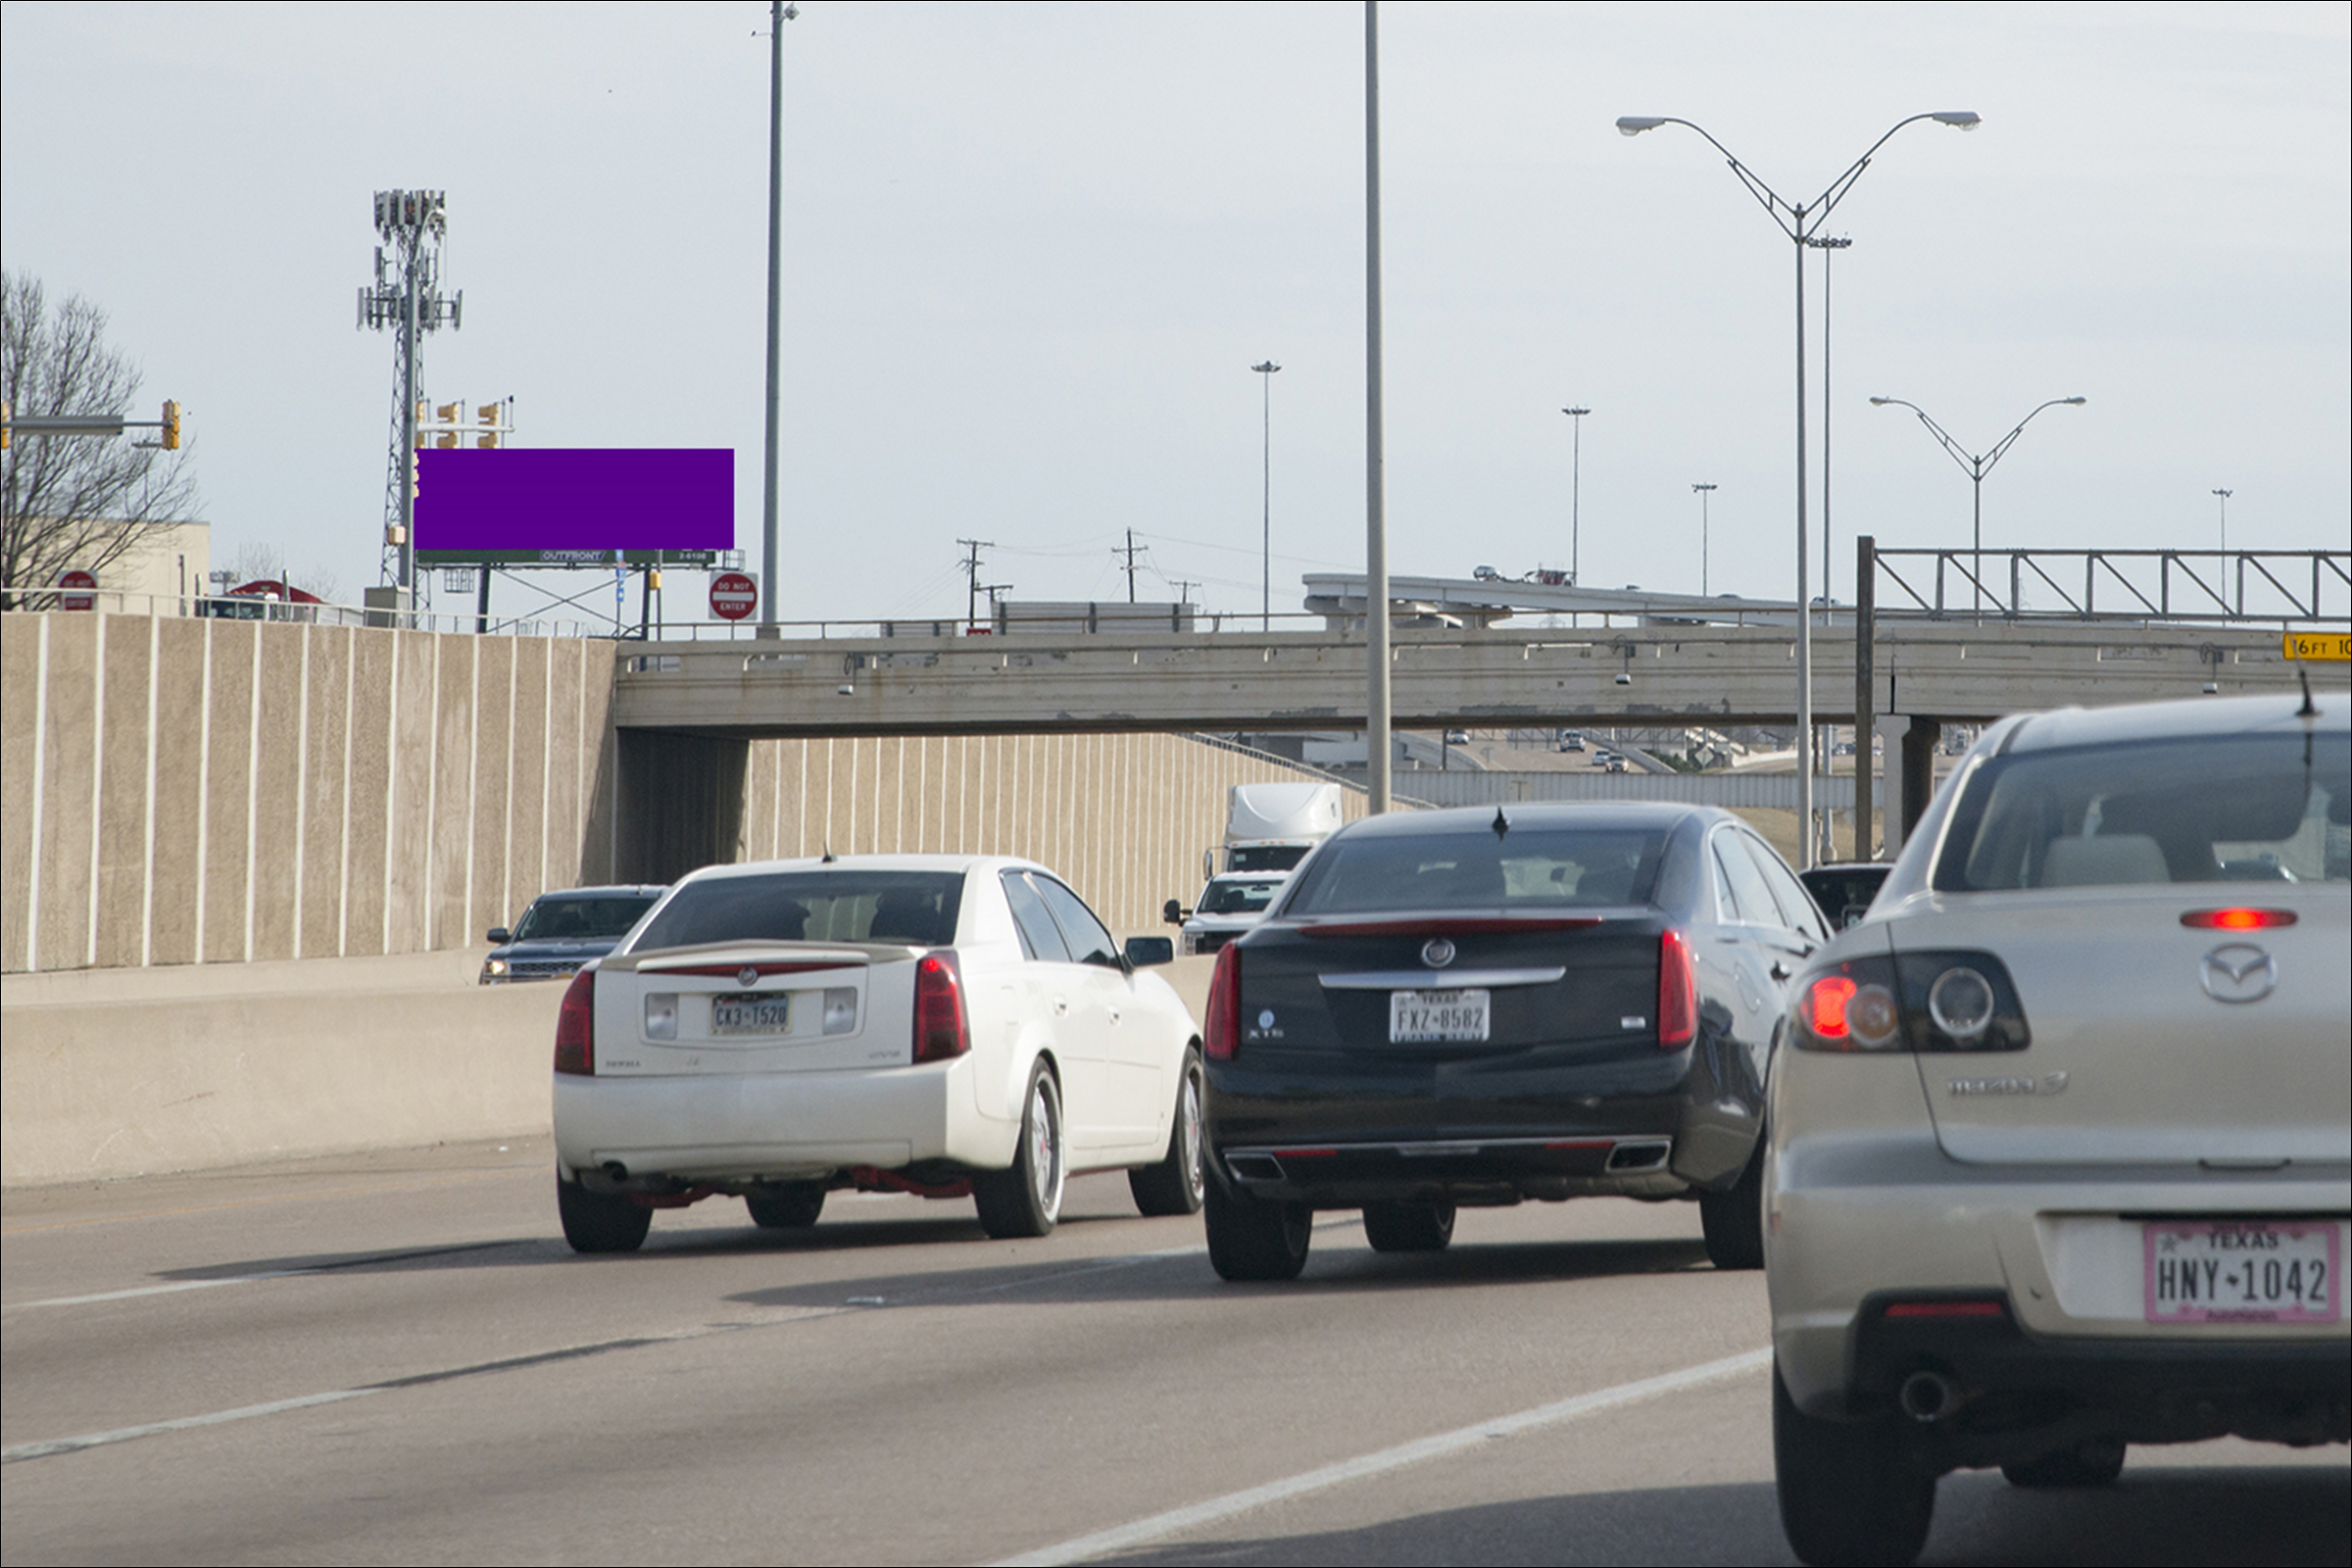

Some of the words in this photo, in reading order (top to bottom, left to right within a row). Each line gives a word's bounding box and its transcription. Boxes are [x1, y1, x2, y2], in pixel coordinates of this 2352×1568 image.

[542, 551, 601, 561] OUTFRONT
[717, 582, 730, 591] DO
[733, 582, 751, 591] NOT
[719, 602, 747, 612] ENTER
[2207, 1232, 2279, 1250] TEXAS
